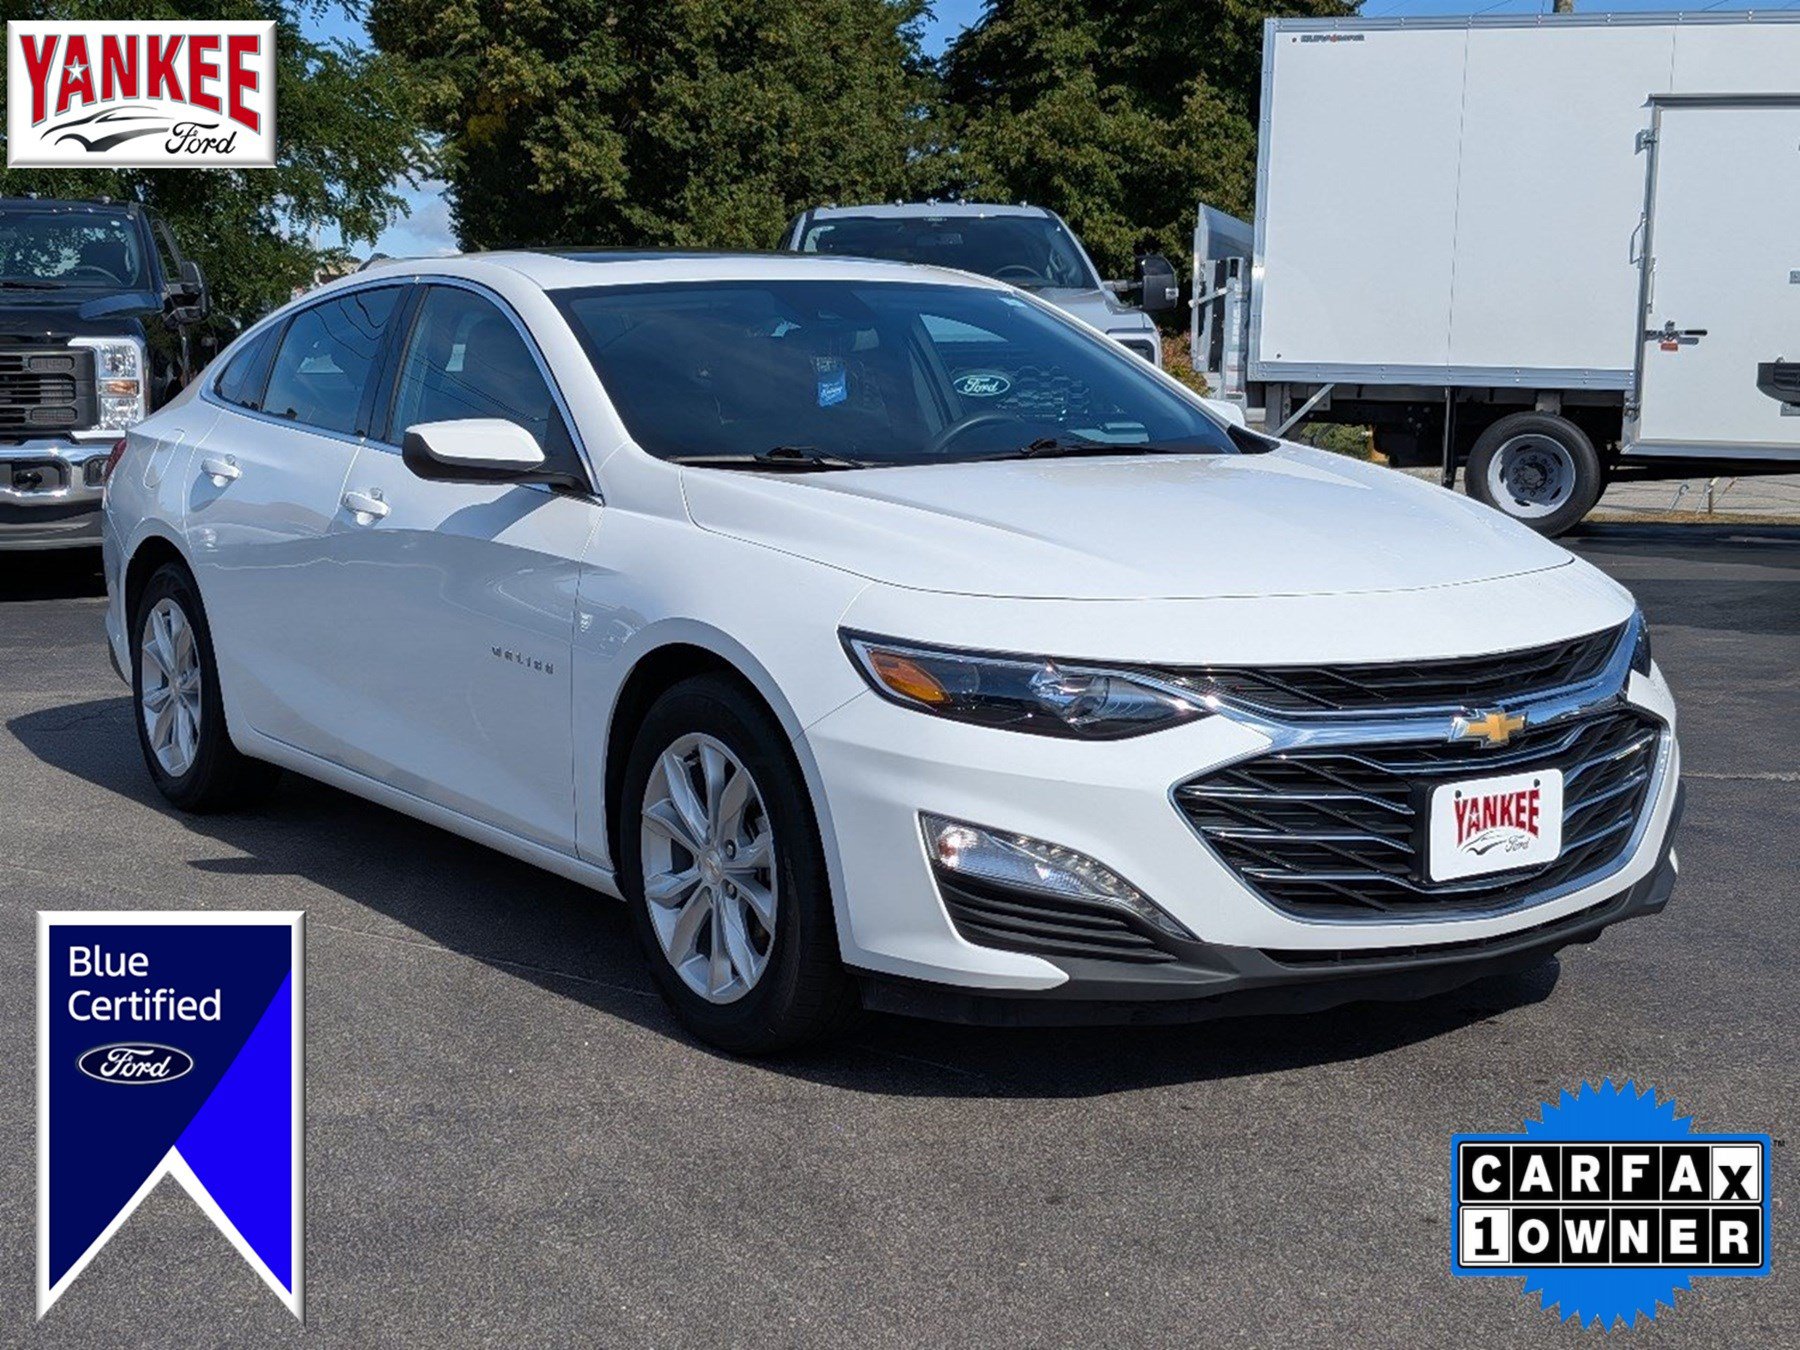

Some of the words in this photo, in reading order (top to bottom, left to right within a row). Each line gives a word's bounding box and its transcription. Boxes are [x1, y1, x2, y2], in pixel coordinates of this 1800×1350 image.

[962, 377, 1000, 393] Ford
[1453, 788, 1540, 848] YANKEE
[1505, 835, 1531, 853] Ford
